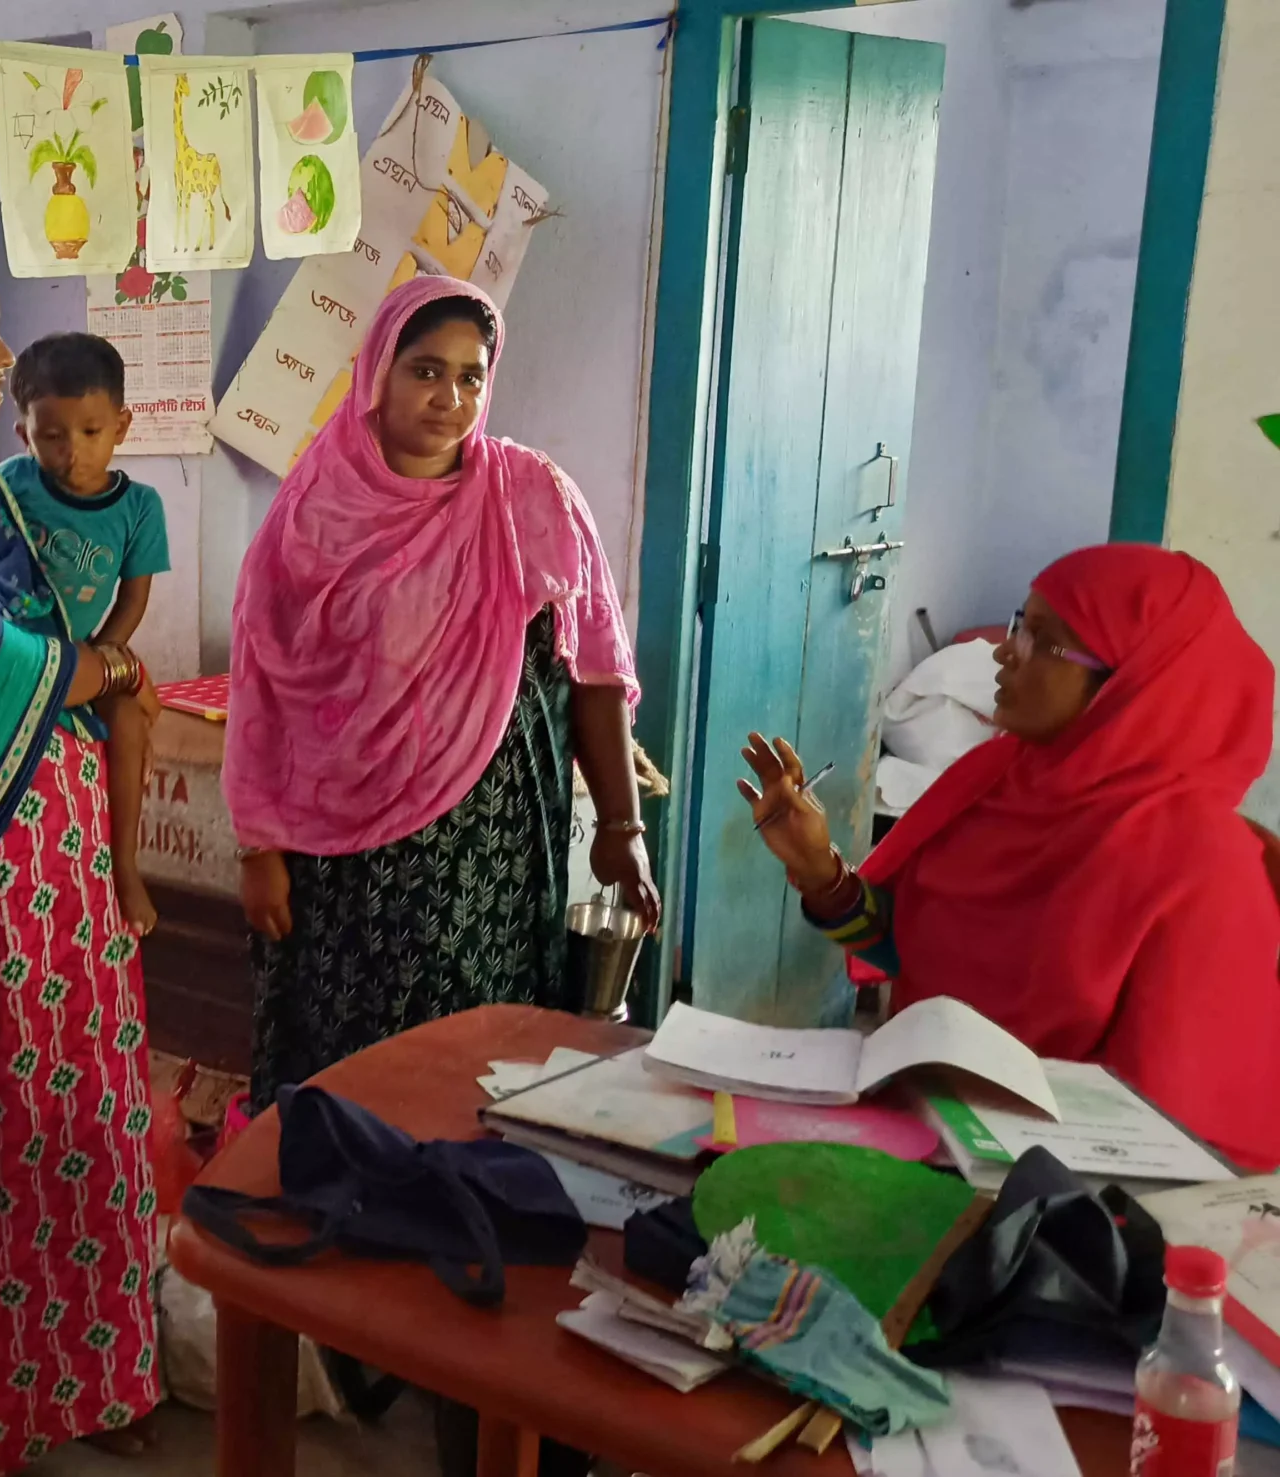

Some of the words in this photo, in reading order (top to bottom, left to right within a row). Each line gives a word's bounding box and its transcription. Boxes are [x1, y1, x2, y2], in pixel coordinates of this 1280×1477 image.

[419, 95, 451, 125] এখন
[372, 156, 418, 194] এখন
[311, 289, 358, 329] আজ
[275, 348, 316, 383] আজ
[237, 407, 280, 436] এখন
